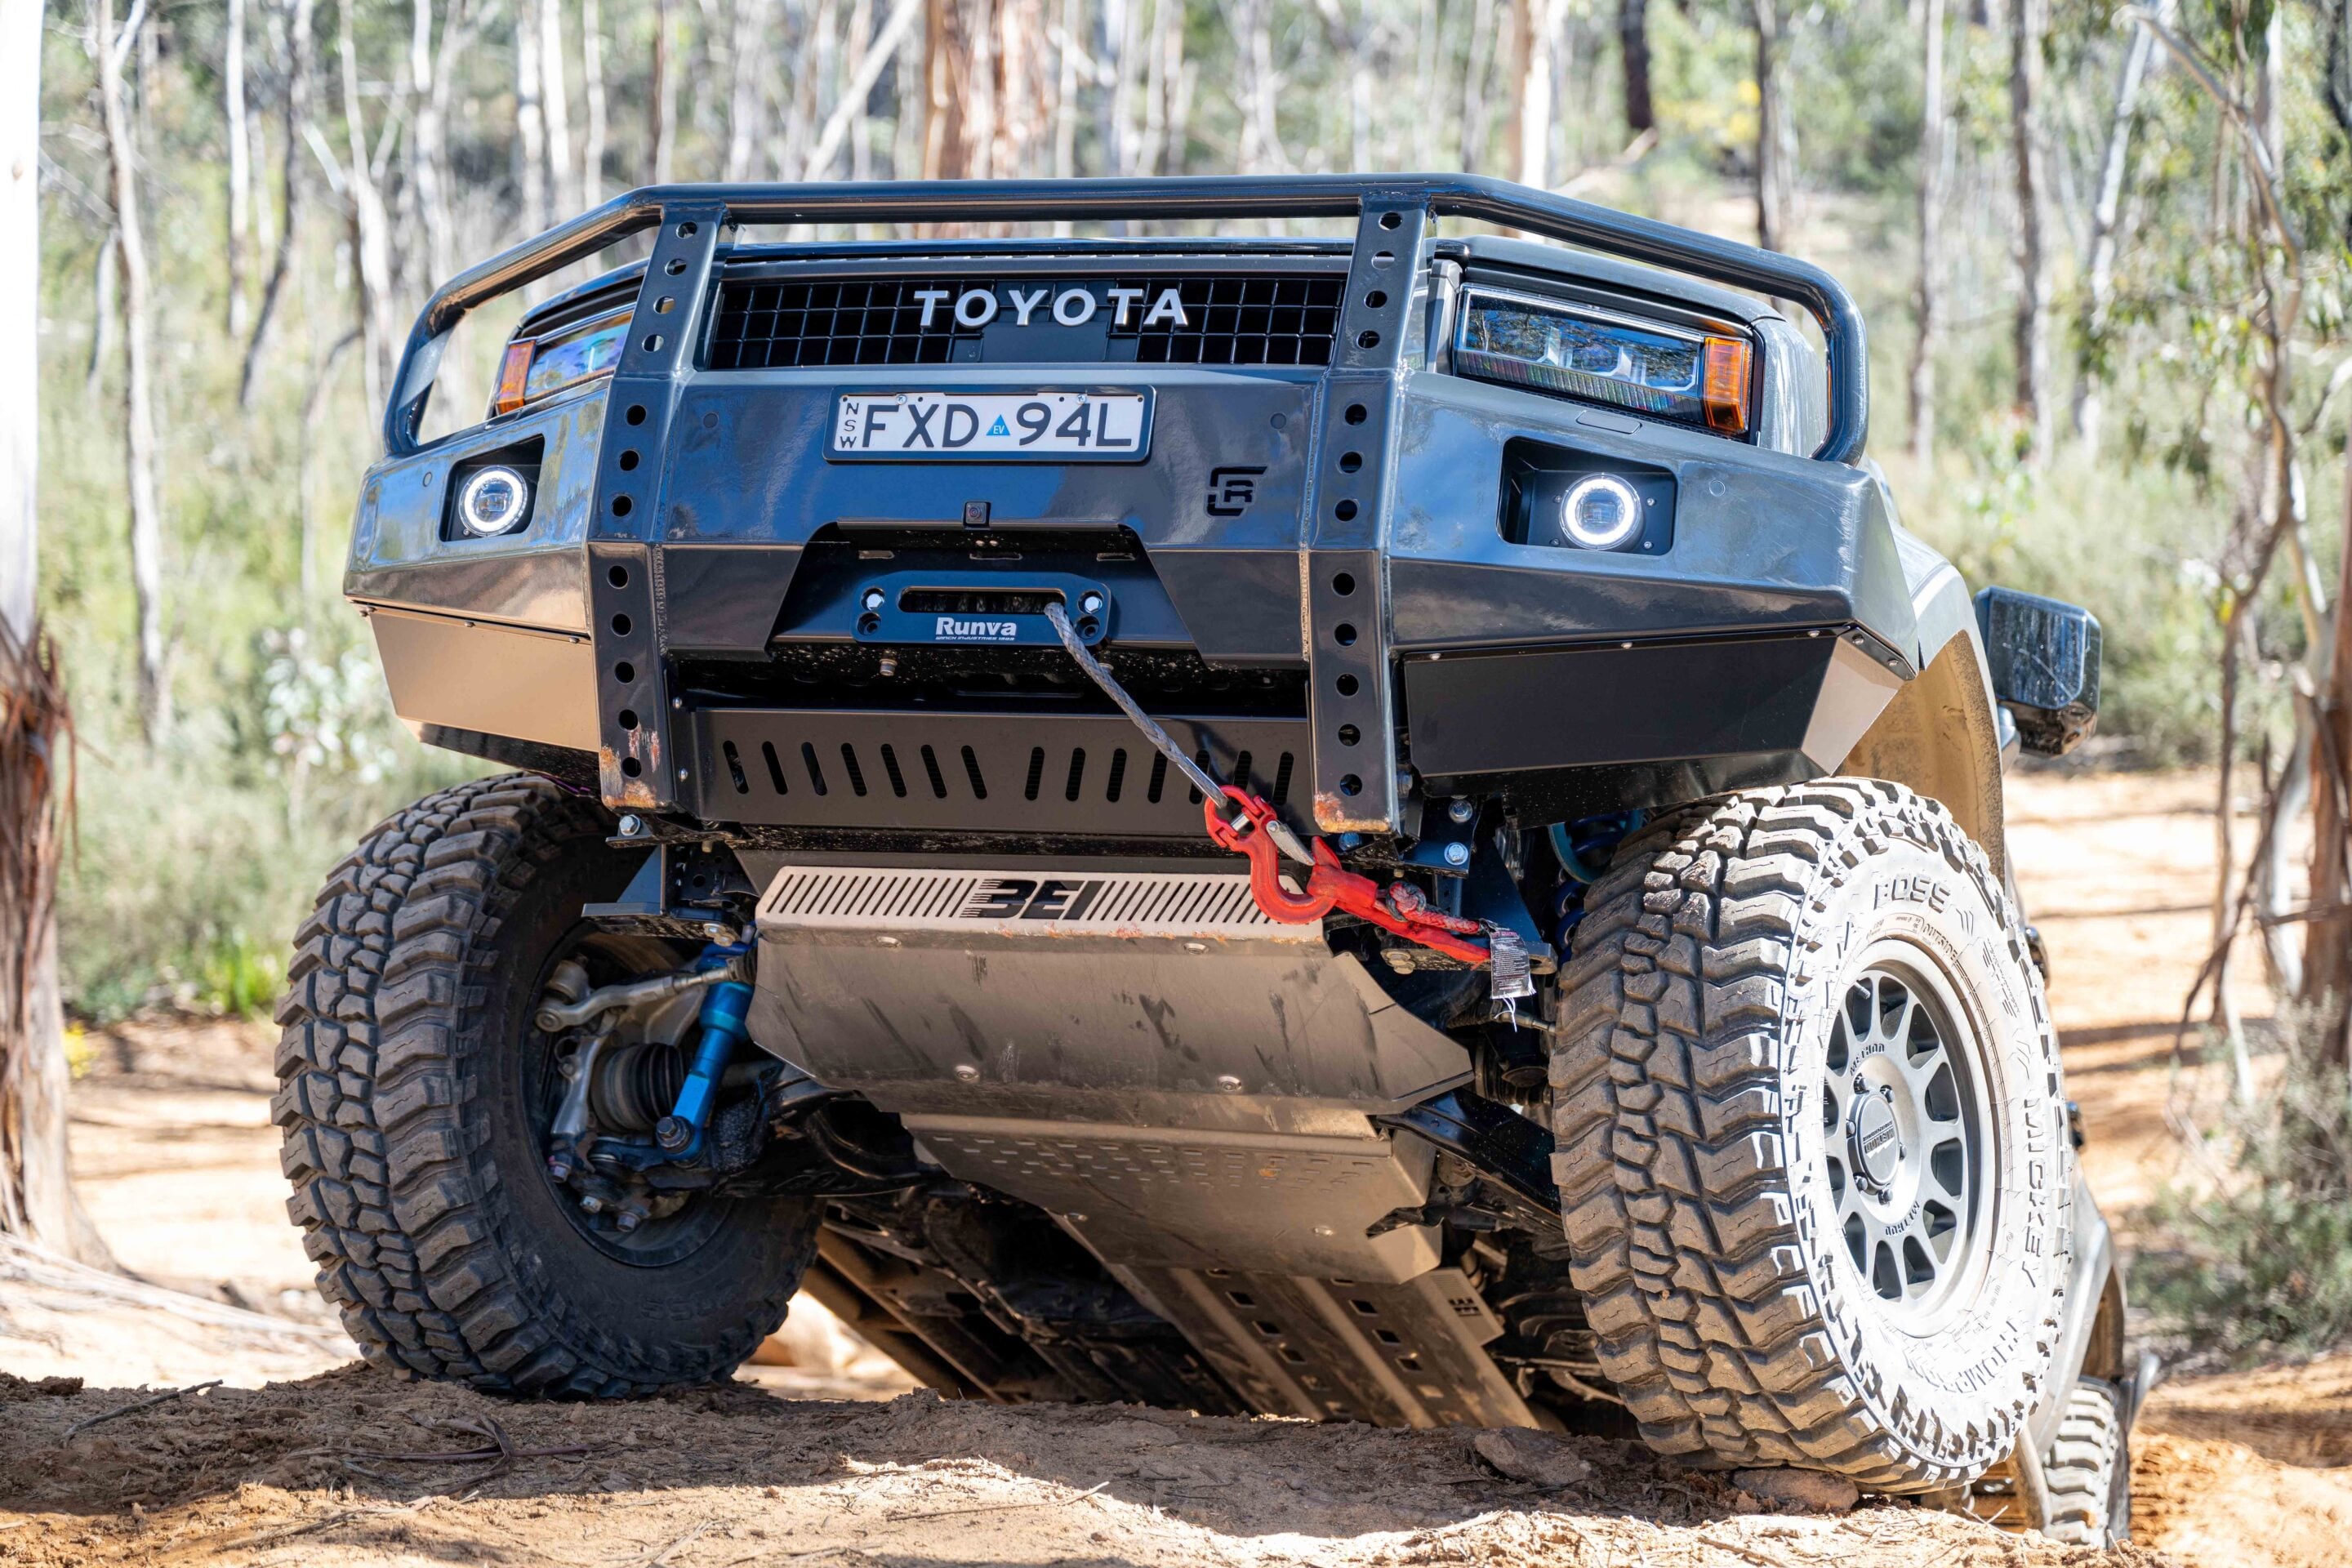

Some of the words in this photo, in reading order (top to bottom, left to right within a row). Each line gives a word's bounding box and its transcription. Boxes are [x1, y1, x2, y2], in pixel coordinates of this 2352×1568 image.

[913, 287, 1188, 327] TOYOTA
[840, 402, 859, 448] NSW
[862, 403, 979, 448] FXD
[1016, 402, 1132, 447] 94L
[935, 617, 1017, 636] Runva
